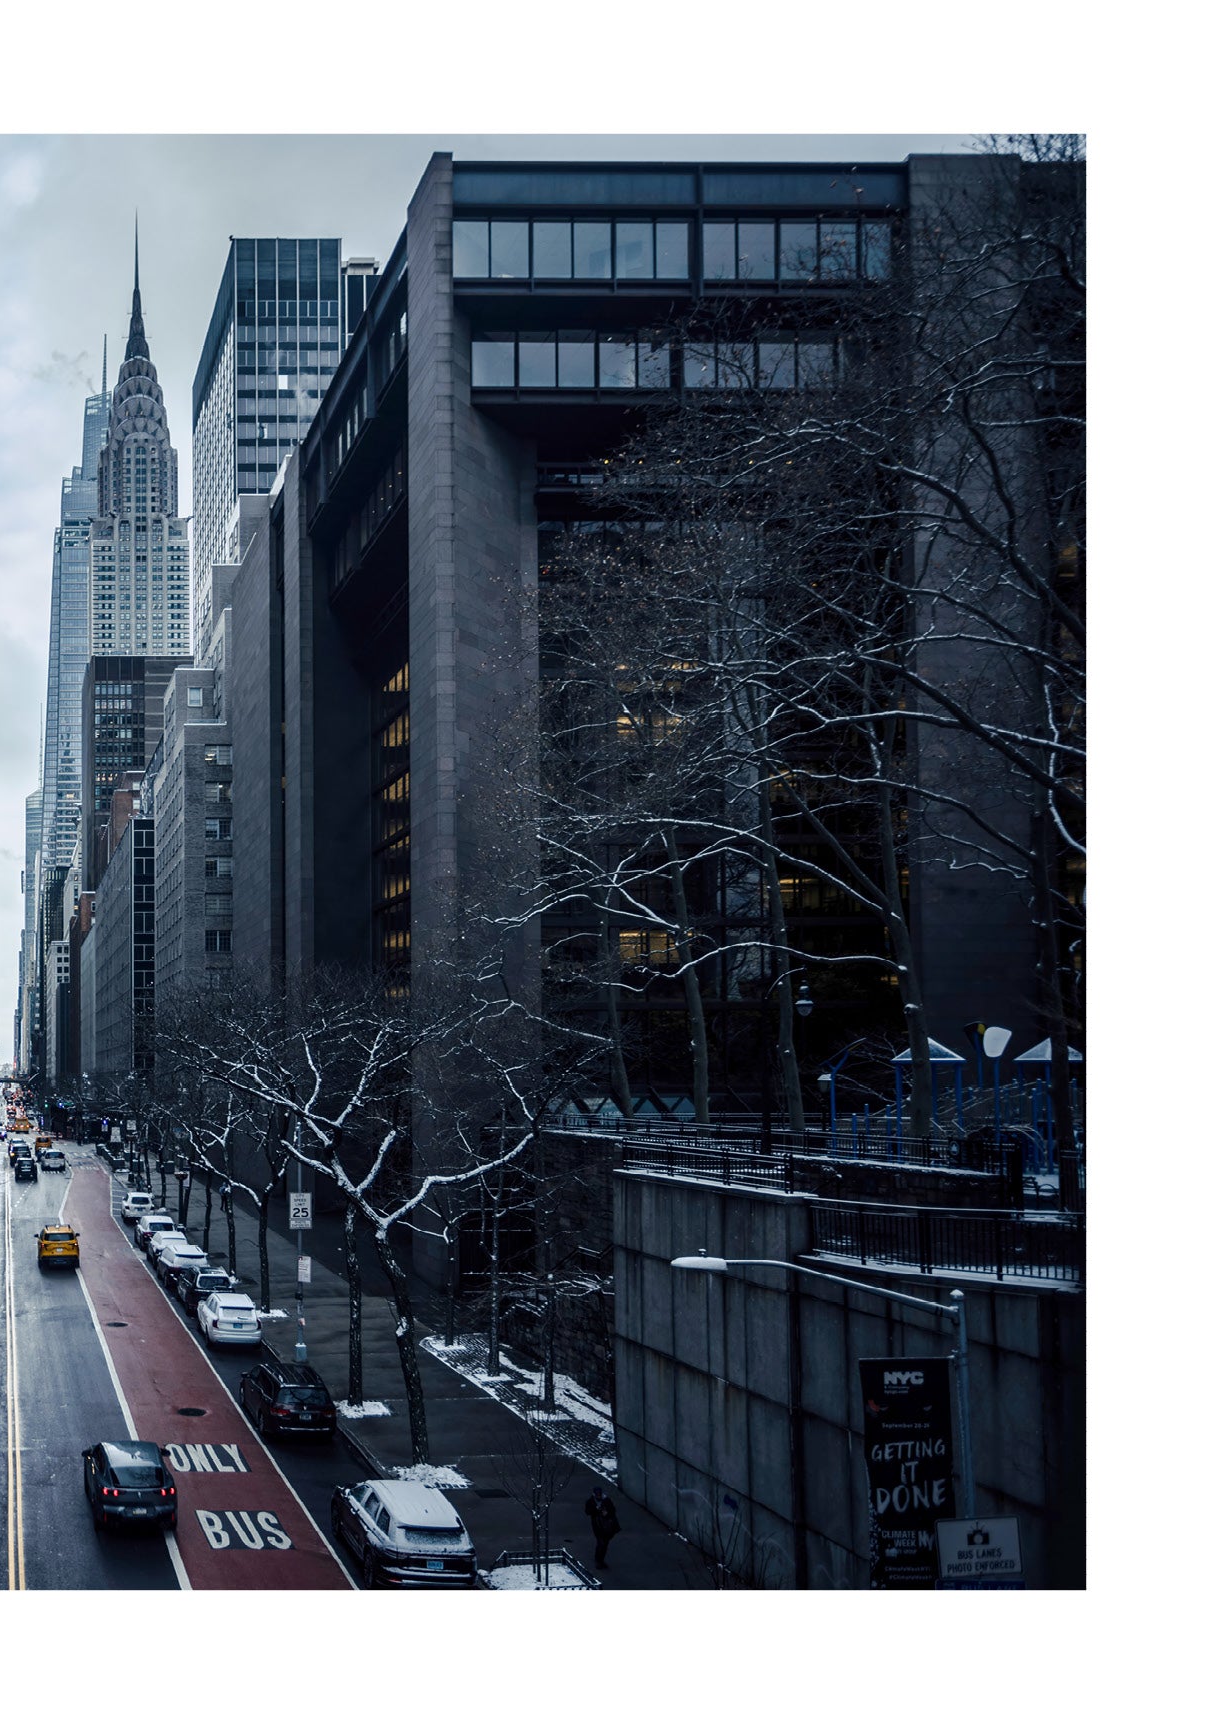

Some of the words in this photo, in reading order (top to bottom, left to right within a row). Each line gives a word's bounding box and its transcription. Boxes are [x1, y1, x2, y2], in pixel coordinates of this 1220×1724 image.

[292, 1207, 309, 1218] 25
[884, 1371, 924, 1385] NYC
[871, 1437, 946, 1462] GETTING
[164, 1443, 248, 1472] ONLY
[900, 1461, 919, 1484] IT
[876, 1478, 947, 1514] DONE
[196, 1509, 292, 1550] BUS
[881, 1530, 916, 1538] CLIMATE
[894, 1538, 916, 1546] WEEK
[957, 1550, 974, 1560] BUS
[976, 1548, 1002, 1559] LANES
[947, 1562, 972, 1573] PHOTO
[975, 1560, 1015, 1571] ENFORCED
